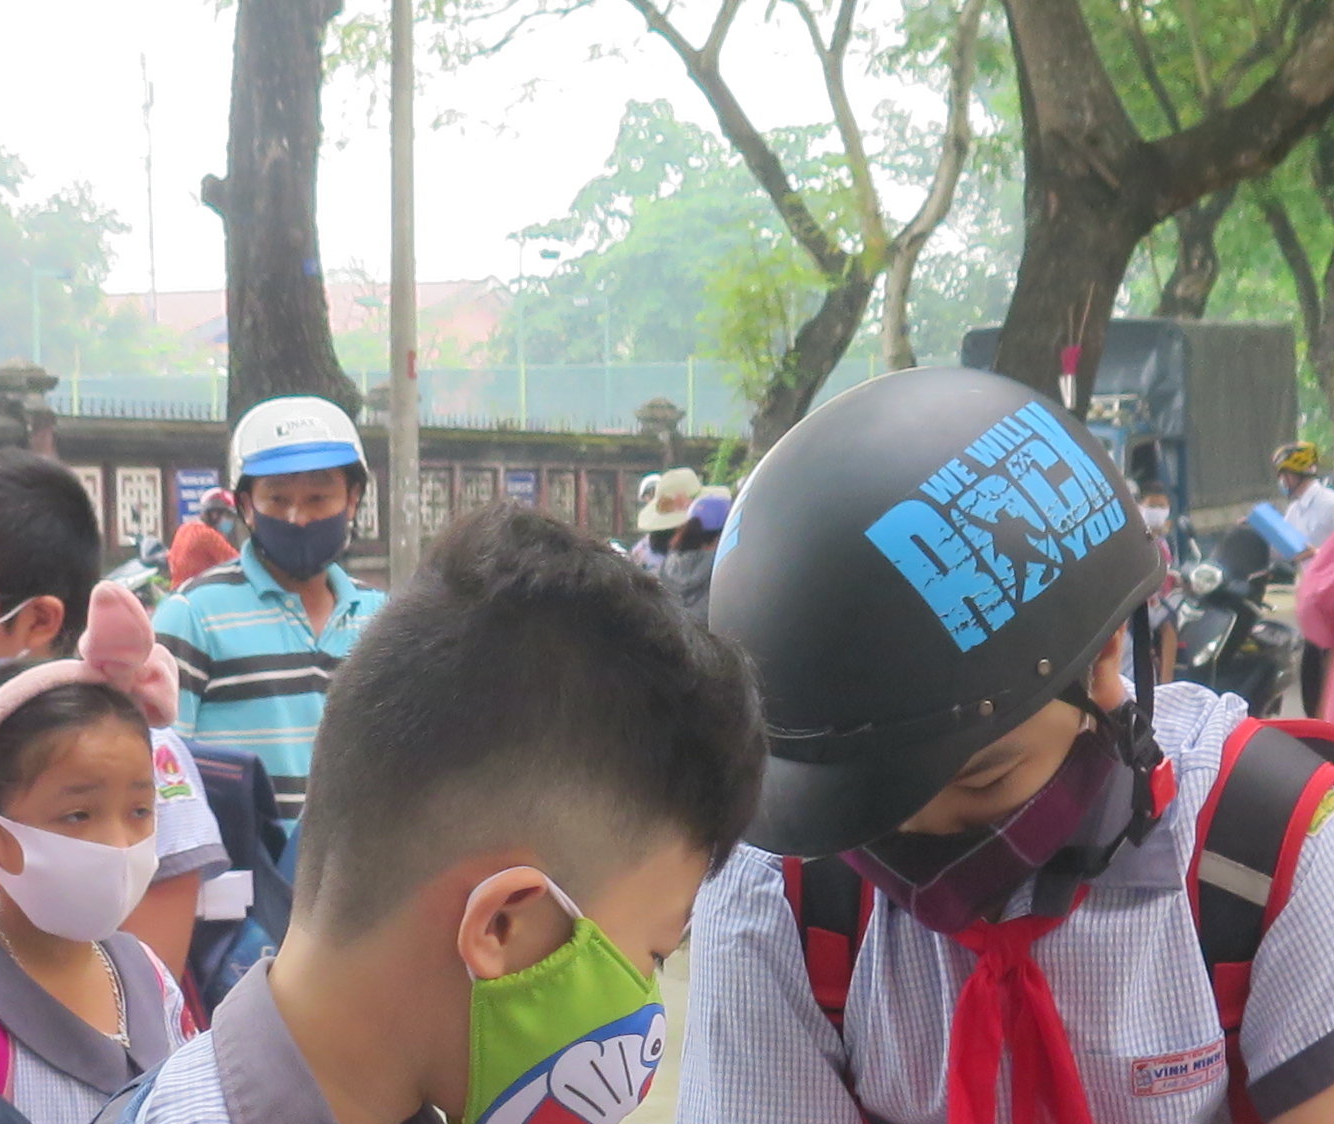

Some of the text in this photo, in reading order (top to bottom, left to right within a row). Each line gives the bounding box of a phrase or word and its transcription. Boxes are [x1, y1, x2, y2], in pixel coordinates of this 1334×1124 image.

[919, 415, 1034, 505] WE WILL
[1061, 498, 1127, 561] YOU
